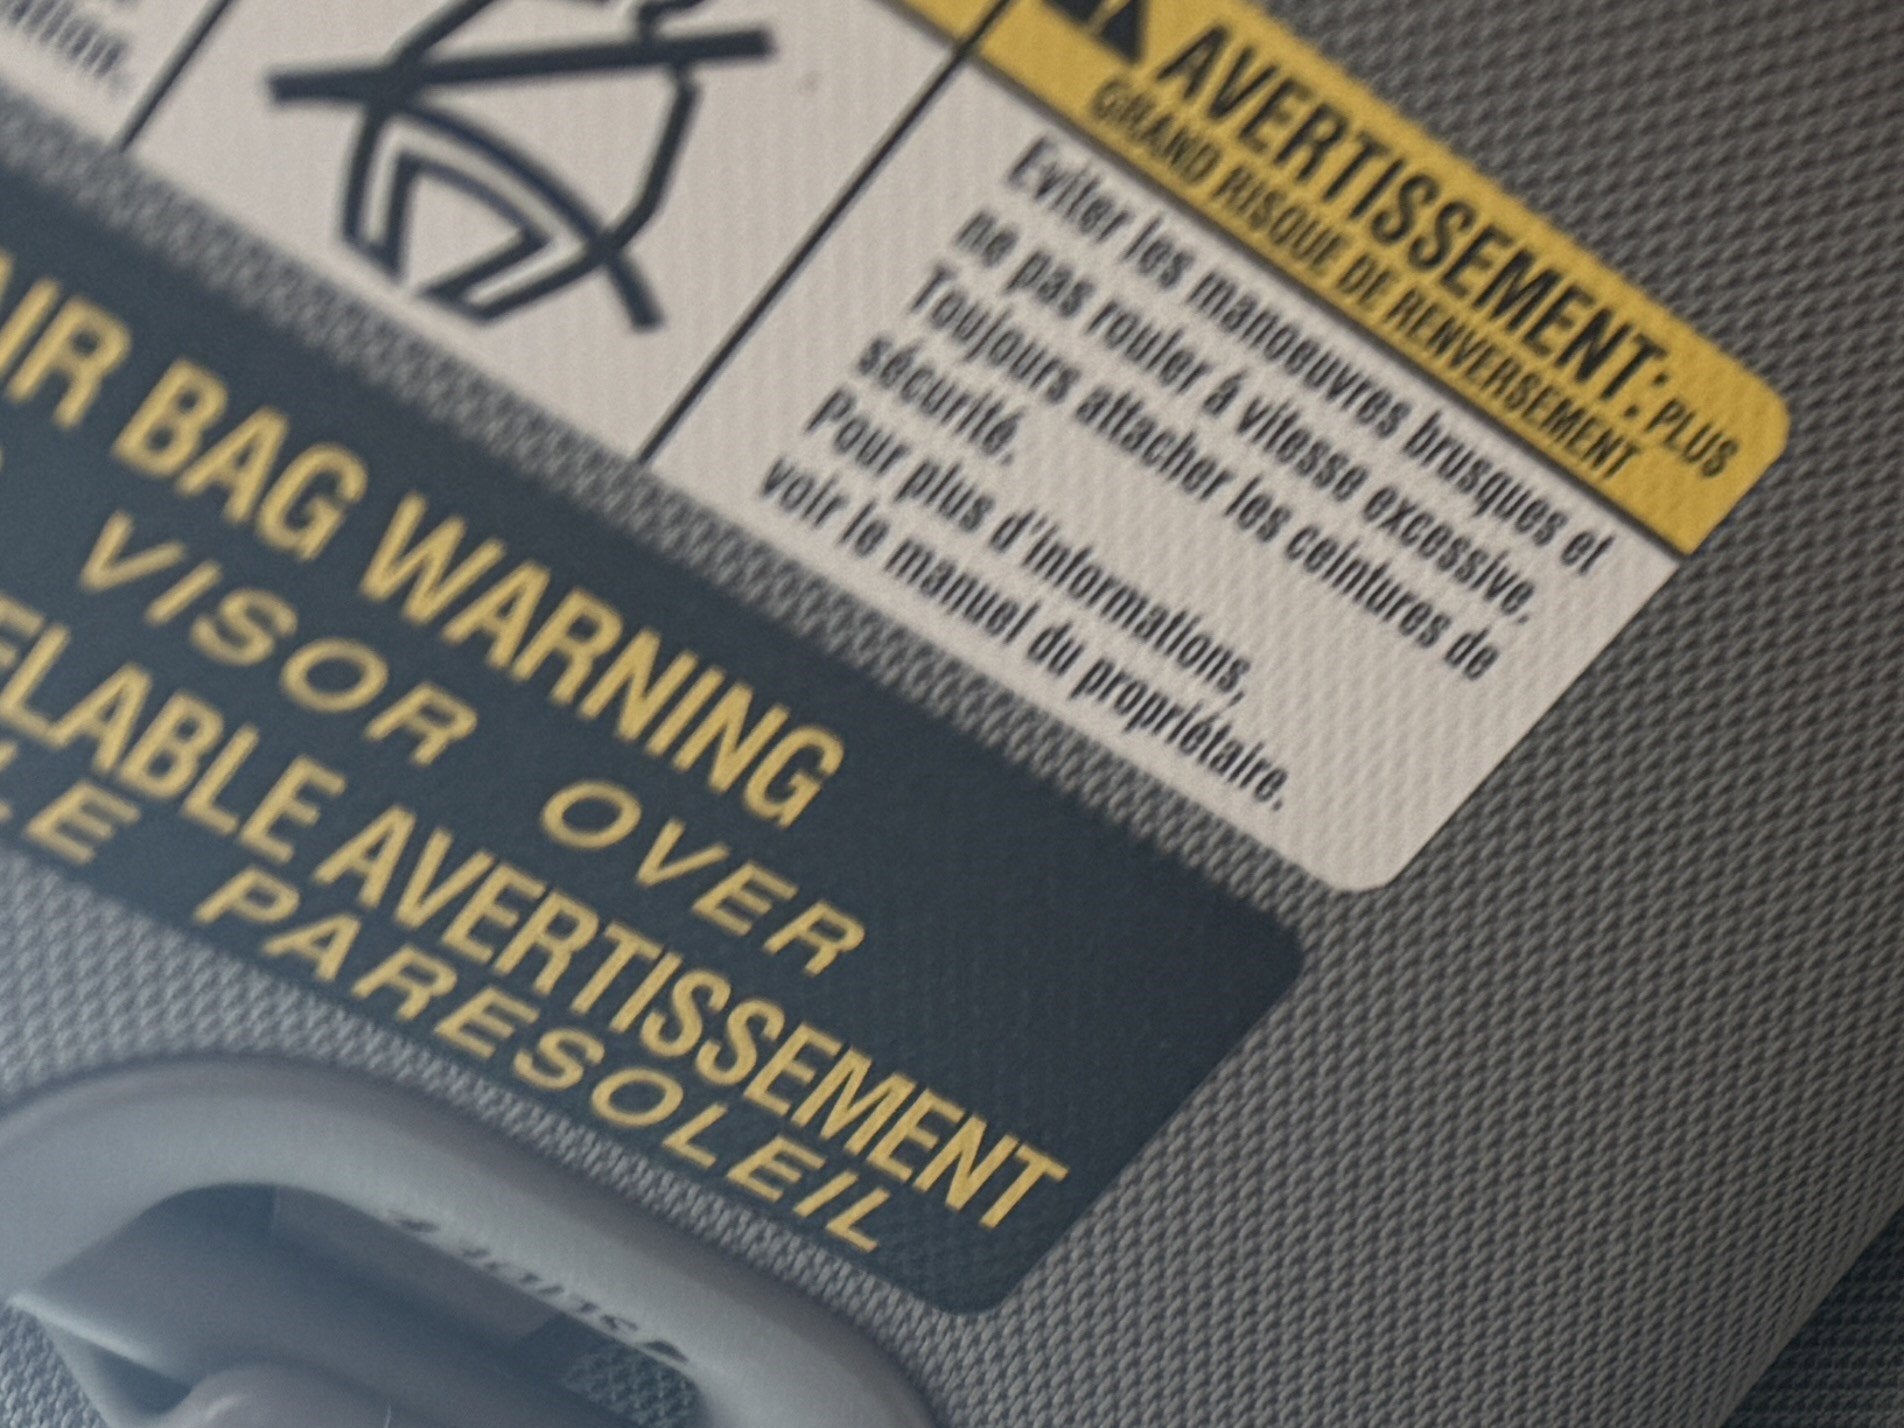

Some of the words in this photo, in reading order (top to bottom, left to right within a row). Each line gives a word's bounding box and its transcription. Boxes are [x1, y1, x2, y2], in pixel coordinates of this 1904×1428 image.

[804, 384, 914, 478] Pour
[895, 459, 998, 534] plus
[854, 333, 1027, 468] sécurité.
[954, 209, 1019, 270] ne
[1002, 251, 1097, 320] pas
[1084, 299, 1213, 396] rouler
[1236, 396, 1371, 502] vitesse
[1361, 485, 1536, 626] excessive.
[1092, 75, 1222, 186] GRAND
[1212, 165, 1347, 279] RISQUE
[1337, 253, 1393, 312] DE
[1382, 287, 1642, 480] RENVERSEMENT
[1122, 215, 1195, 293] les
[1185, 270, 1412, 439] manoeuvres
[1403, 410, 1569, 547] brusques
[1560, 530, 1617, 575] et
[1154, 25, 1670, 418] AVERTISSEMENT:
[1645, 398, 1739, 480] PLUS
[0, 248, 131, 432] IR
[110, 355, 369, 562] BAG
[357, 490, 845, 829] WARNING
[760, 454, 850, 530] voir
[836, 498, 892, 559] le
[882, 537, 1042, 648] manuel
[1025, 619, 1086, 679] du
[1067, 654, 1290, 812] propriétaire.
[910, 260, 1083, 404] Toujours
[1073, 383, 1238, 500] attacher
[1223, 472, 1293, 543] les
[1284, 522, 1453, 650] ceintures
[1443, 627, 1501, 682] de
[78, 508, 480, 772] VISOR
[538, 778, 868, 978] OVER
[0, 735, 142, 866] E
[191, 863, 893, 1256] PARESOLEIL
[310, 803, 1070, 1232] AVERTISSEMENT
